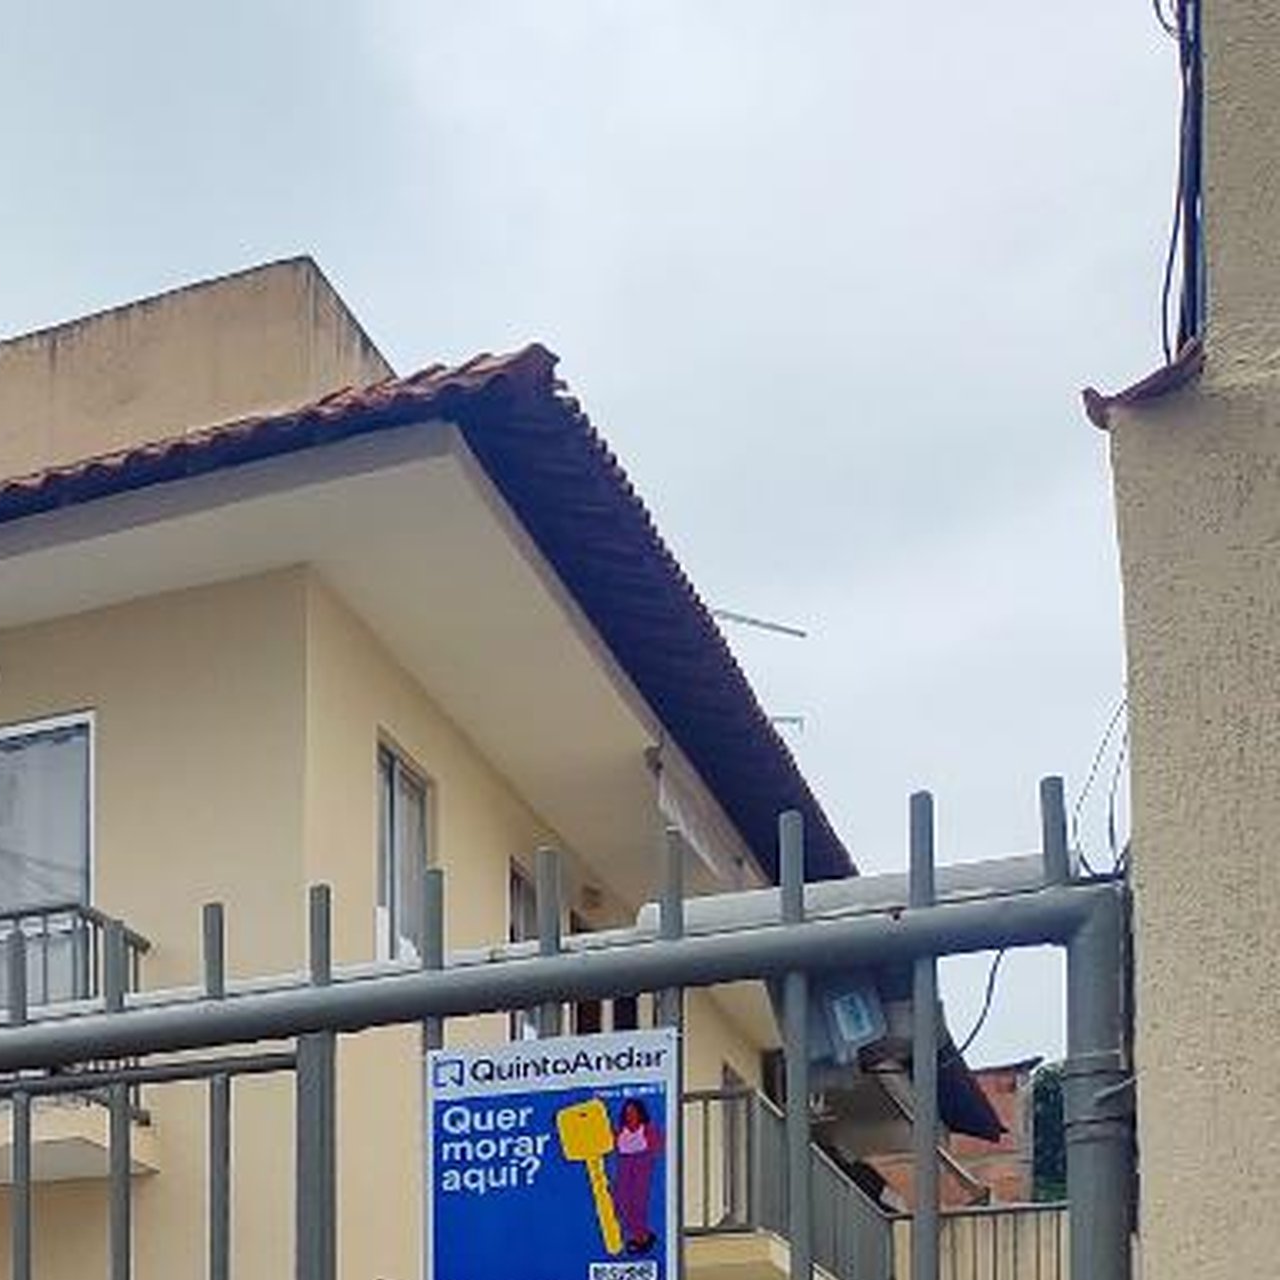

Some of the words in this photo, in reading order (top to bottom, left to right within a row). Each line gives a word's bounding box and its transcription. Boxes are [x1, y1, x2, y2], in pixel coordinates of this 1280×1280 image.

[470, 1047, 667, 1081] QuintoAndar
[442, 1105, 533, 1134] Quer
[442, 1133, 550, 1162] morar
[442, 1157, 540, 1194] aqui?
